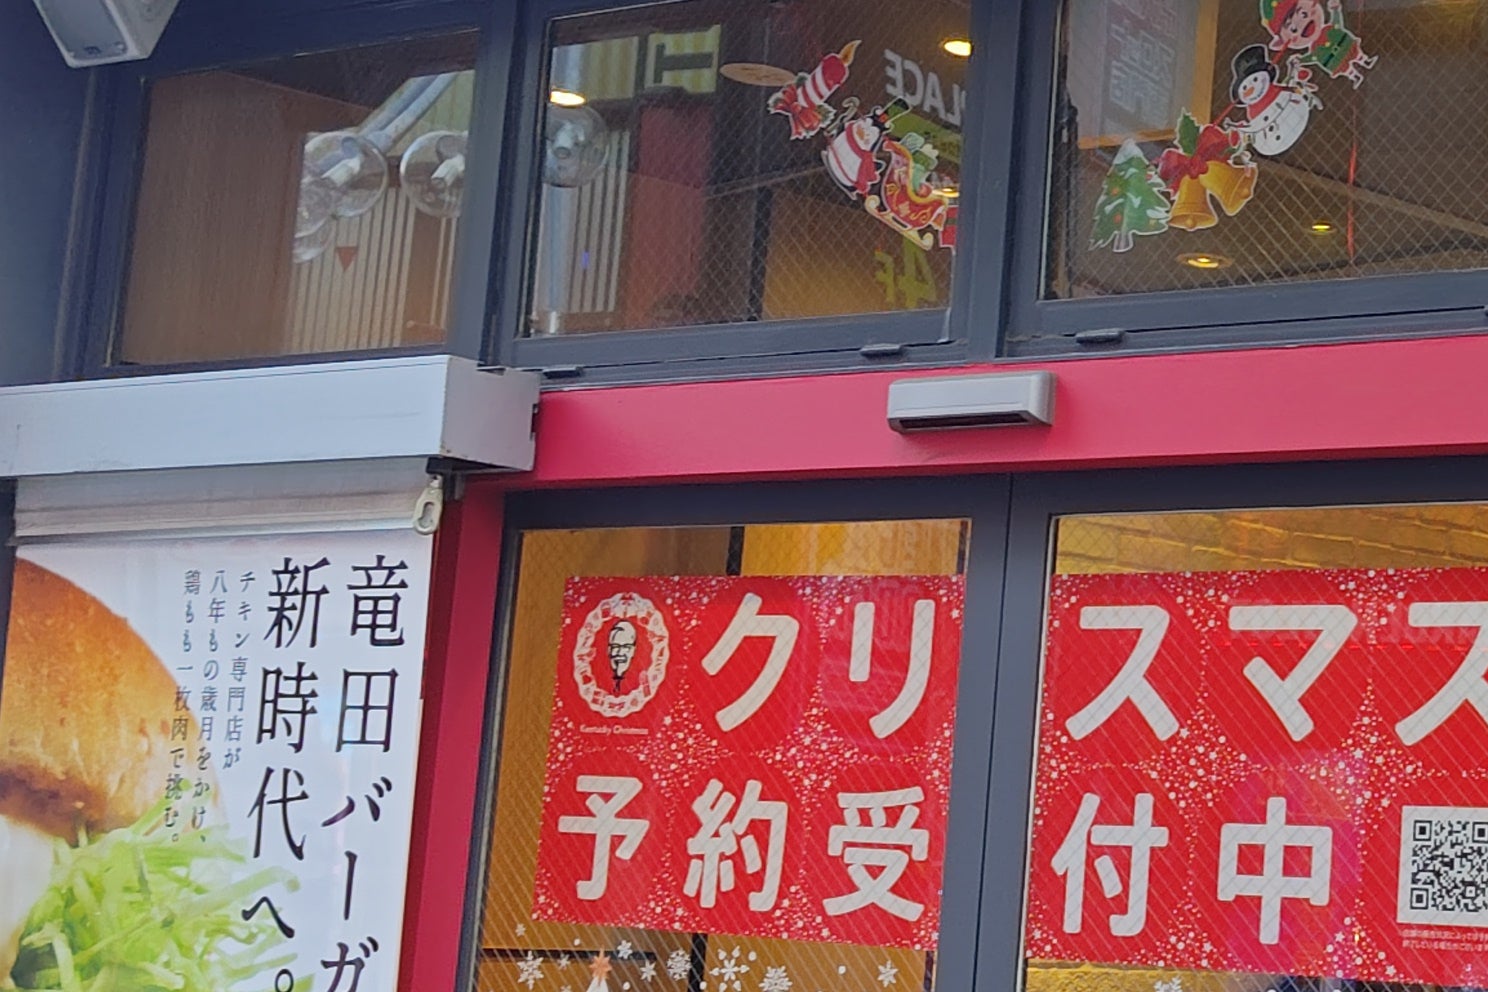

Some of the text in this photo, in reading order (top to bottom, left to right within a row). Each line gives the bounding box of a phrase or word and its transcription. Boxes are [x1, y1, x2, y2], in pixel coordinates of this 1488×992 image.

[222, 571, 257, 770] チキン専門店が
[241, 556, 331, 992] 新時代へ。
